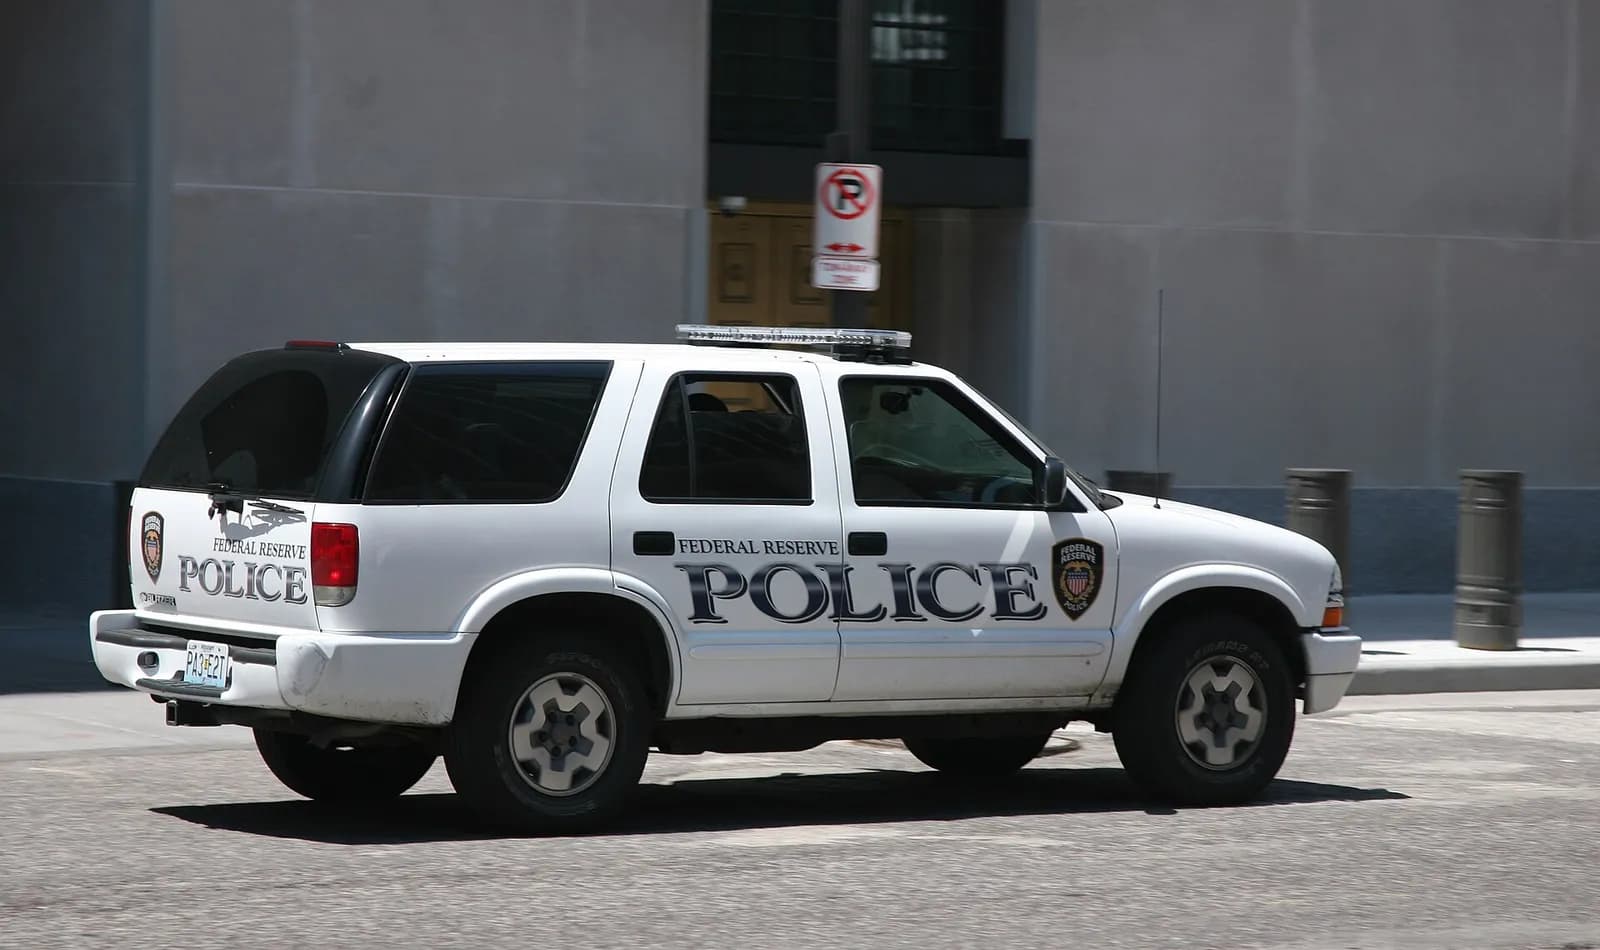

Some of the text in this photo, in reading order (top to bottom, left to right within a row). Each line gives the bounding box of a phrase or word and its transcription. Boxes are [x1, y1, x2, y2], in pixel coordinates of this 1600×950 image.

[213, 537, 307, 560] FEDERAL RESERVE
[679, 539, 841, 555] FEDERAL RESERVE
[1061, 543, 1096, 556] FEDERAL
[1061, 551, 1096, 564] RESERVE
[178, 555, 308, 605] POLICE
[674, 561, 1048, 624] POLICE
[1063, 600, 1088, 611] POLICE
